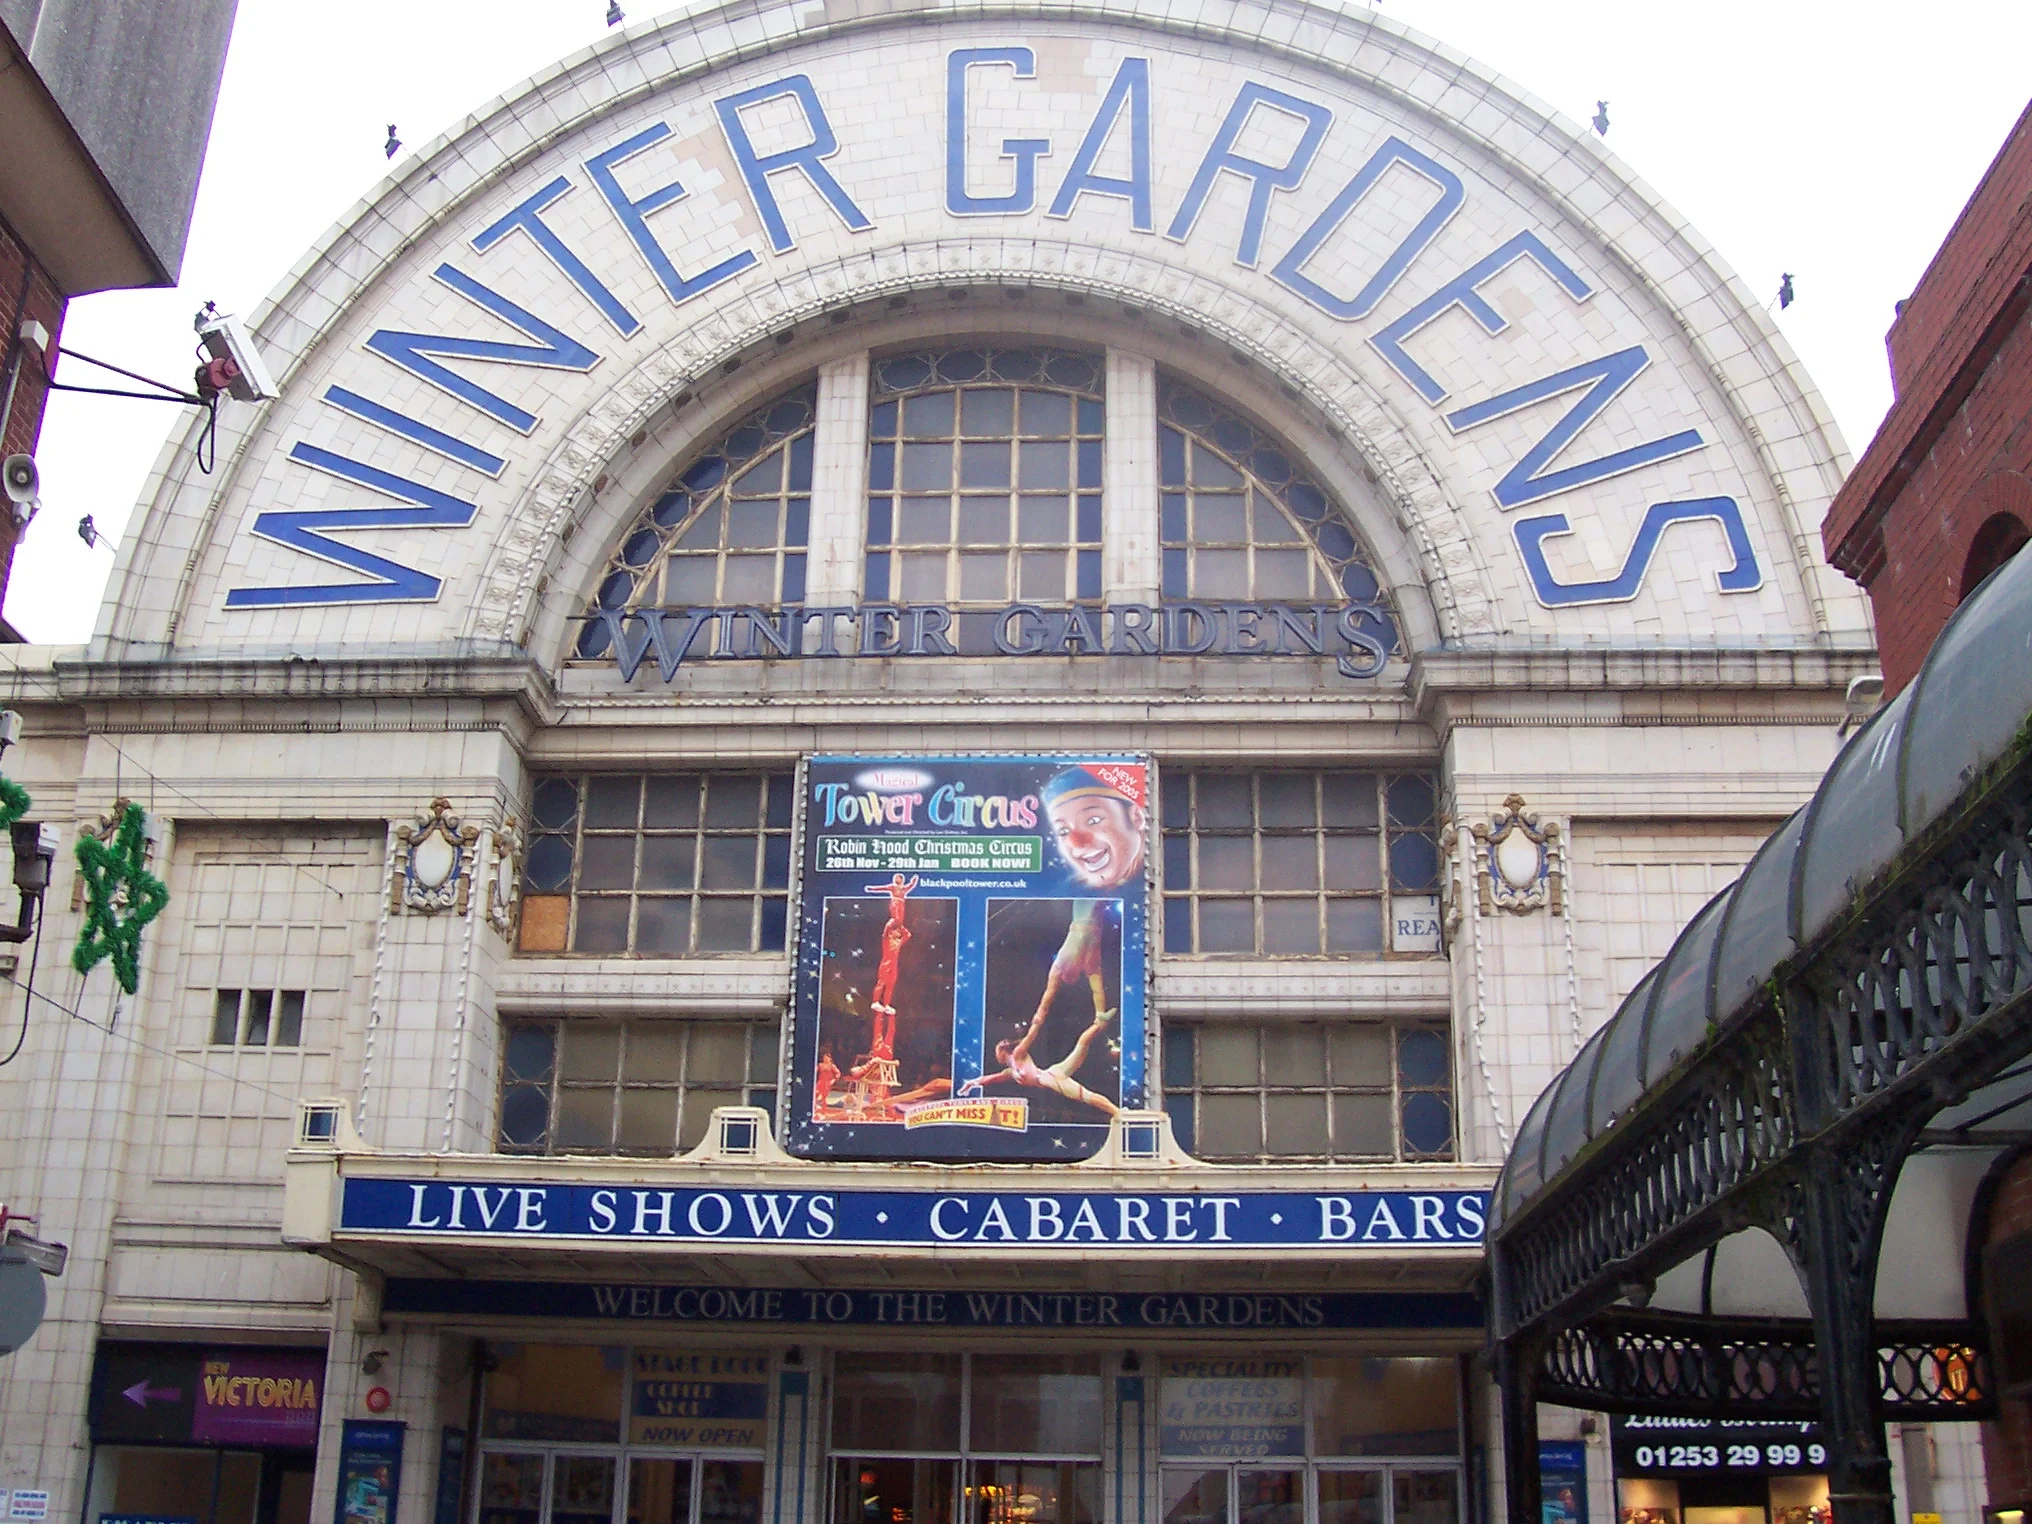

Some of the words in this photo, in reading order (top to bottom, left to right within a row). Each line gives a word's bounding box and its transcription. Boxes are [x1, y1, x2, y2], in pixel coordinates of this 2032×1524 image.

[222, 73, 877, 611] WINTER
[943, 45, 1764, 609] GARDENS
[600, 605, 960, 683] WINTER
[992, 602, 1390, 678] GARDENS
[1097, 768, 1119, 786] FOR
[815, 783, 923, 827] Tower
[928, 781, 1040, 828] Circus
[824, 838, 867, 855] Robin
[871, 838, 910, 855] Hood
[914, 838, 984, 856] Christmas
[988, 838, 1032, 856] Circus
[856, 857, 880, 869] Nov
[918, 858, 940, 869] Jan
[951, 858, 989, 869] BOOK
[992, 858, 1031, 869] NOW!
[920, 877, 1028, 890] blackpooltower.co.uk
[956, 1106, 987, 1120] MISS
[407, 1184, 548, 1231] LIVE
[588, 1190, 836, 1238] SHOWS
[929, 1196, 1241, 1242] CABARET
[1316, 1195, 1485, 1240] BARS
[591, 1286, 783, 1319] WELCOME
[802, 1290, 854, 1322] TO
[870, 1292, 948, 1323] THE
[964, 1294, 1123, 1325] WINTER
[1139, 1295, 1325, 1326] GARDENS
[204, 1376, 316, 1408] VICTORIA
[643, 1427, 694, 1441] NOW
[699, 1427, 753, 1442] OPEN
[1636, 1446, 1719, 1466] 01253
[1727, 1445, 1760, 1466] 29
[1767, 1444, 1801, 1465] 99
